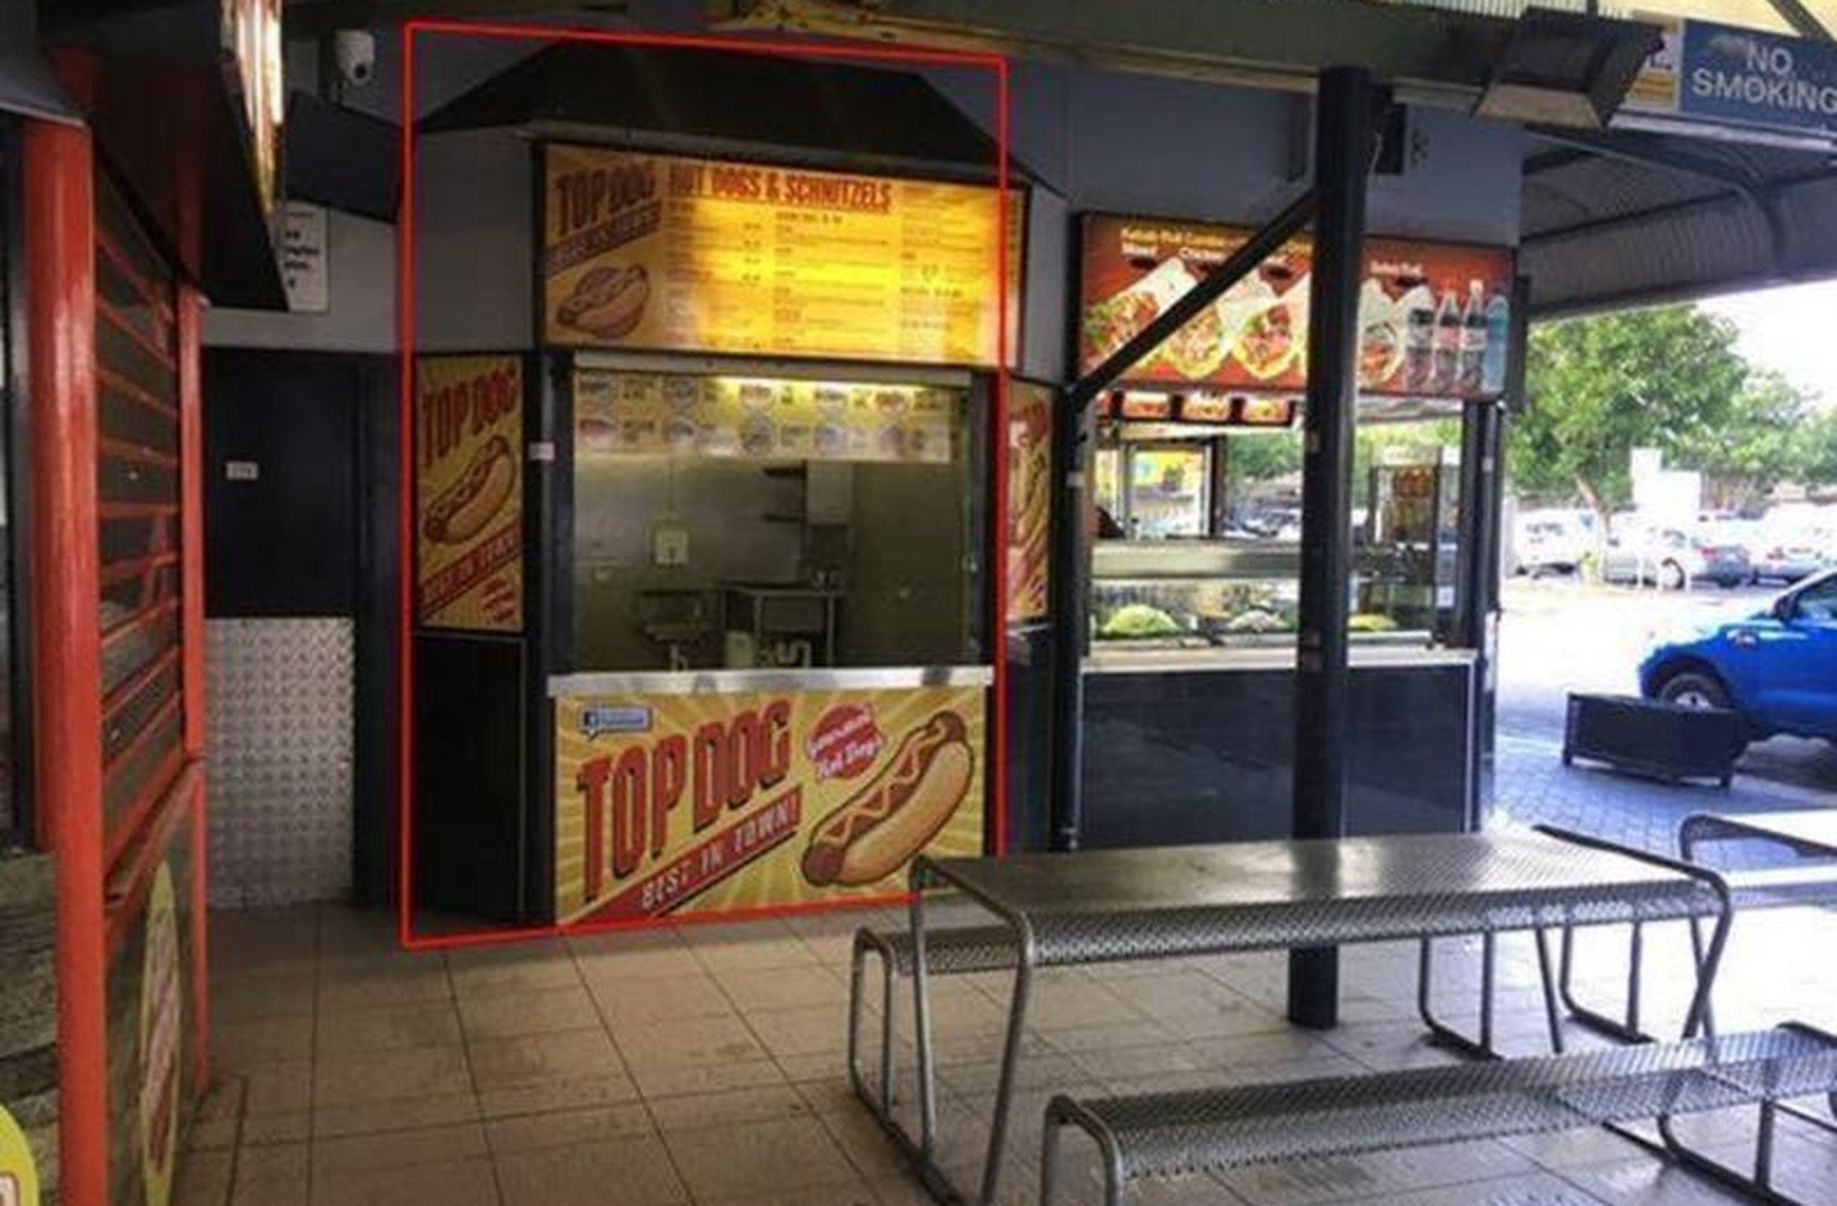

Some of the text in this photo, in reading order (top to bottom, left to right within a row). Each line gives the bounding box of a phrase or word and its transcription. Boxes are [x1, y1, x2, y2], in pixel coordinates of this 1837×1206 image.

[1692, 66, 1837, 115] SMOKING
[1745, 43, 1793, 75] NO
[668, 163, 893, 215] HOT DOGS & SCHNITZELS
[422, 380, 468, 469] TOP
[472, 362, 517, 436] DOG
[575, 699, 791, 904] TOP DOG
[641, 792, 798, 911] BEST IN TOWN!
